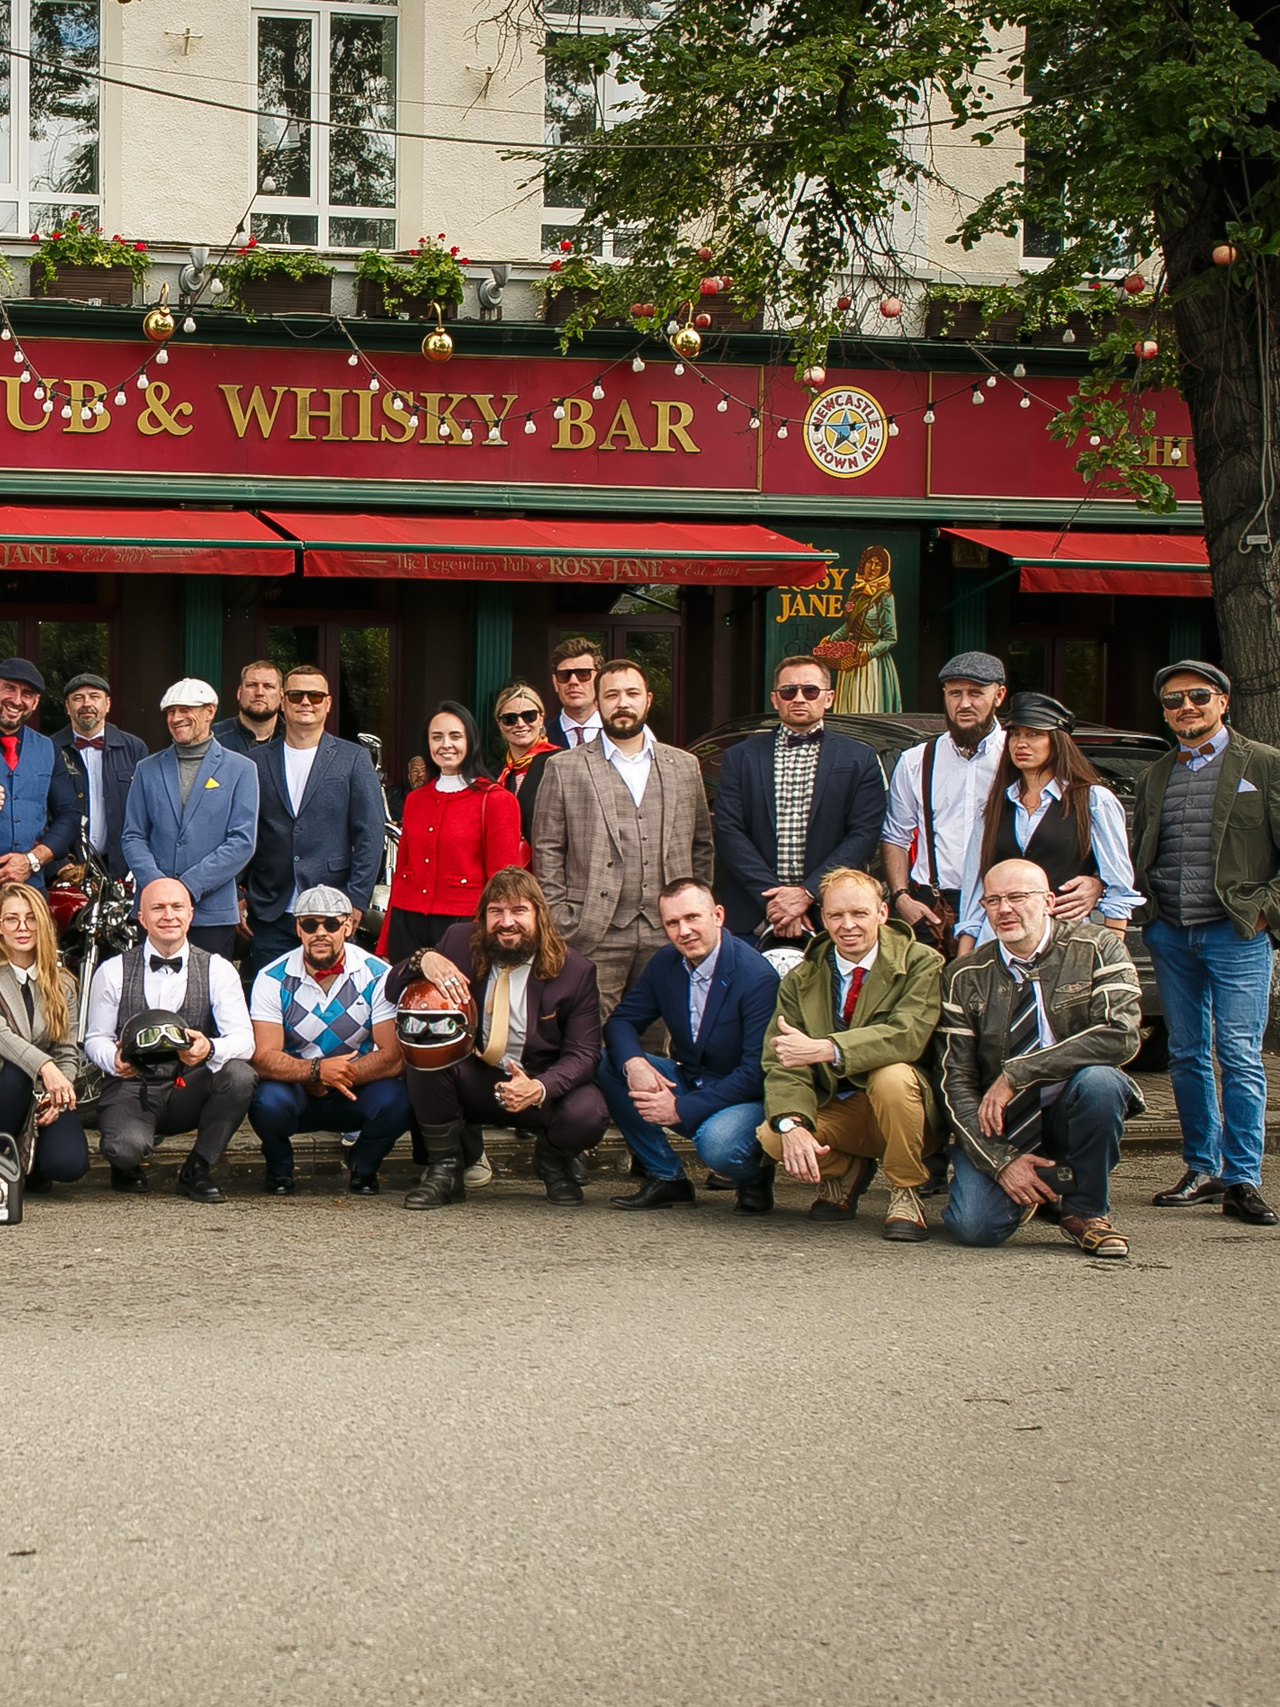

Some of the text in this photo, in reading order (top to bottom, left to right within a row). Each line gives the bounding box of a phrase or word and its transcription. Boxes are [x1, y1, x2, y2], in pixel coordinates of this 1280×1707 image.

[136, 380, 195, 436] &
[217, 383, 519, 446] WHISKY
[551, 397, 702, 453] BAR
[811, 393, 880, 430] NEWCASTLE
[812, 435, 881, 470] ROWN ALE
[422, 555, 498, 575] Legendary
[501, 556, 531, 572] Pub
[547, 556, 607, 576] ROSY
[608, 558, 665, 581] JANE
[775, 593, 845, 623] JANE
